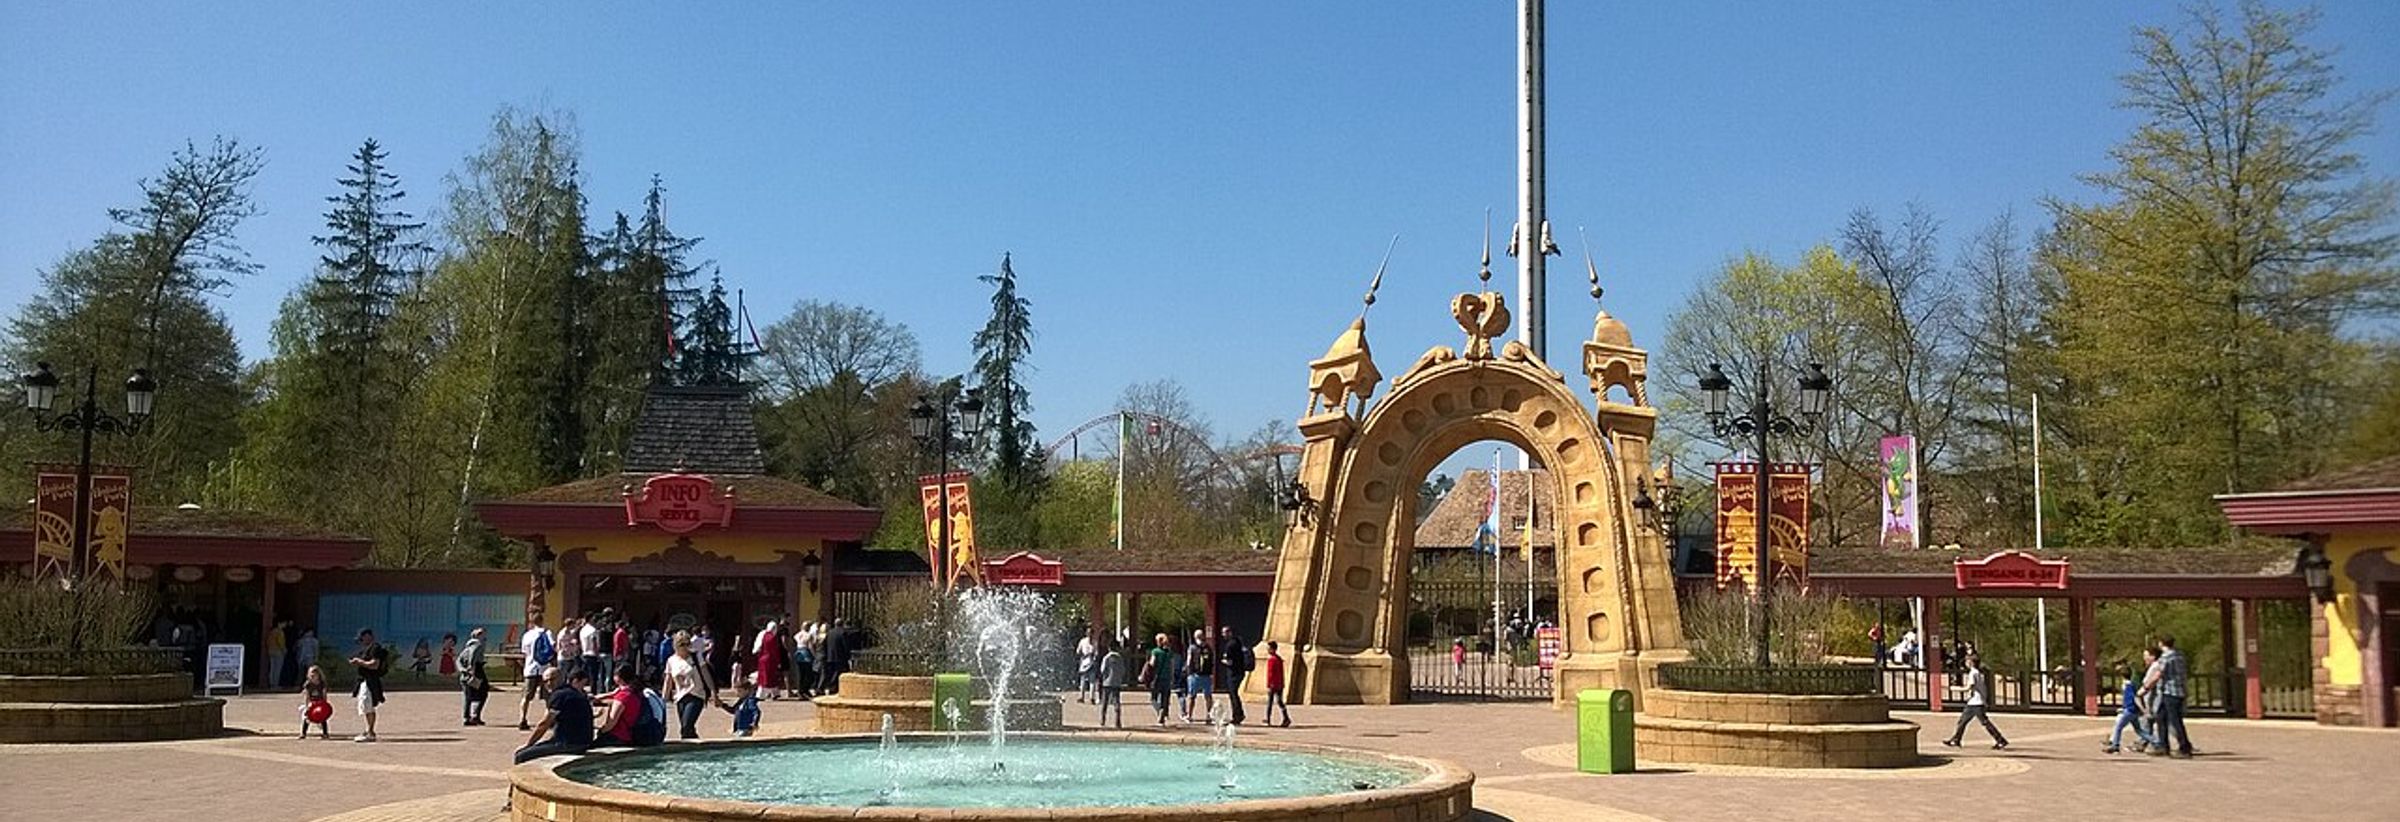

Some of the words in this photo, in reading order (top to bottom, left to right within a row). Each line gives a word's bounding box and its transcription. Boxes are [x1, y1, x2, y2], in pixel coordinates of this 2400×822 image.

[660, 483, 701, 501] INFO
[660, 509, 701, 521] SERVICE
[1971, 569, 2026, 579] EINGANG
